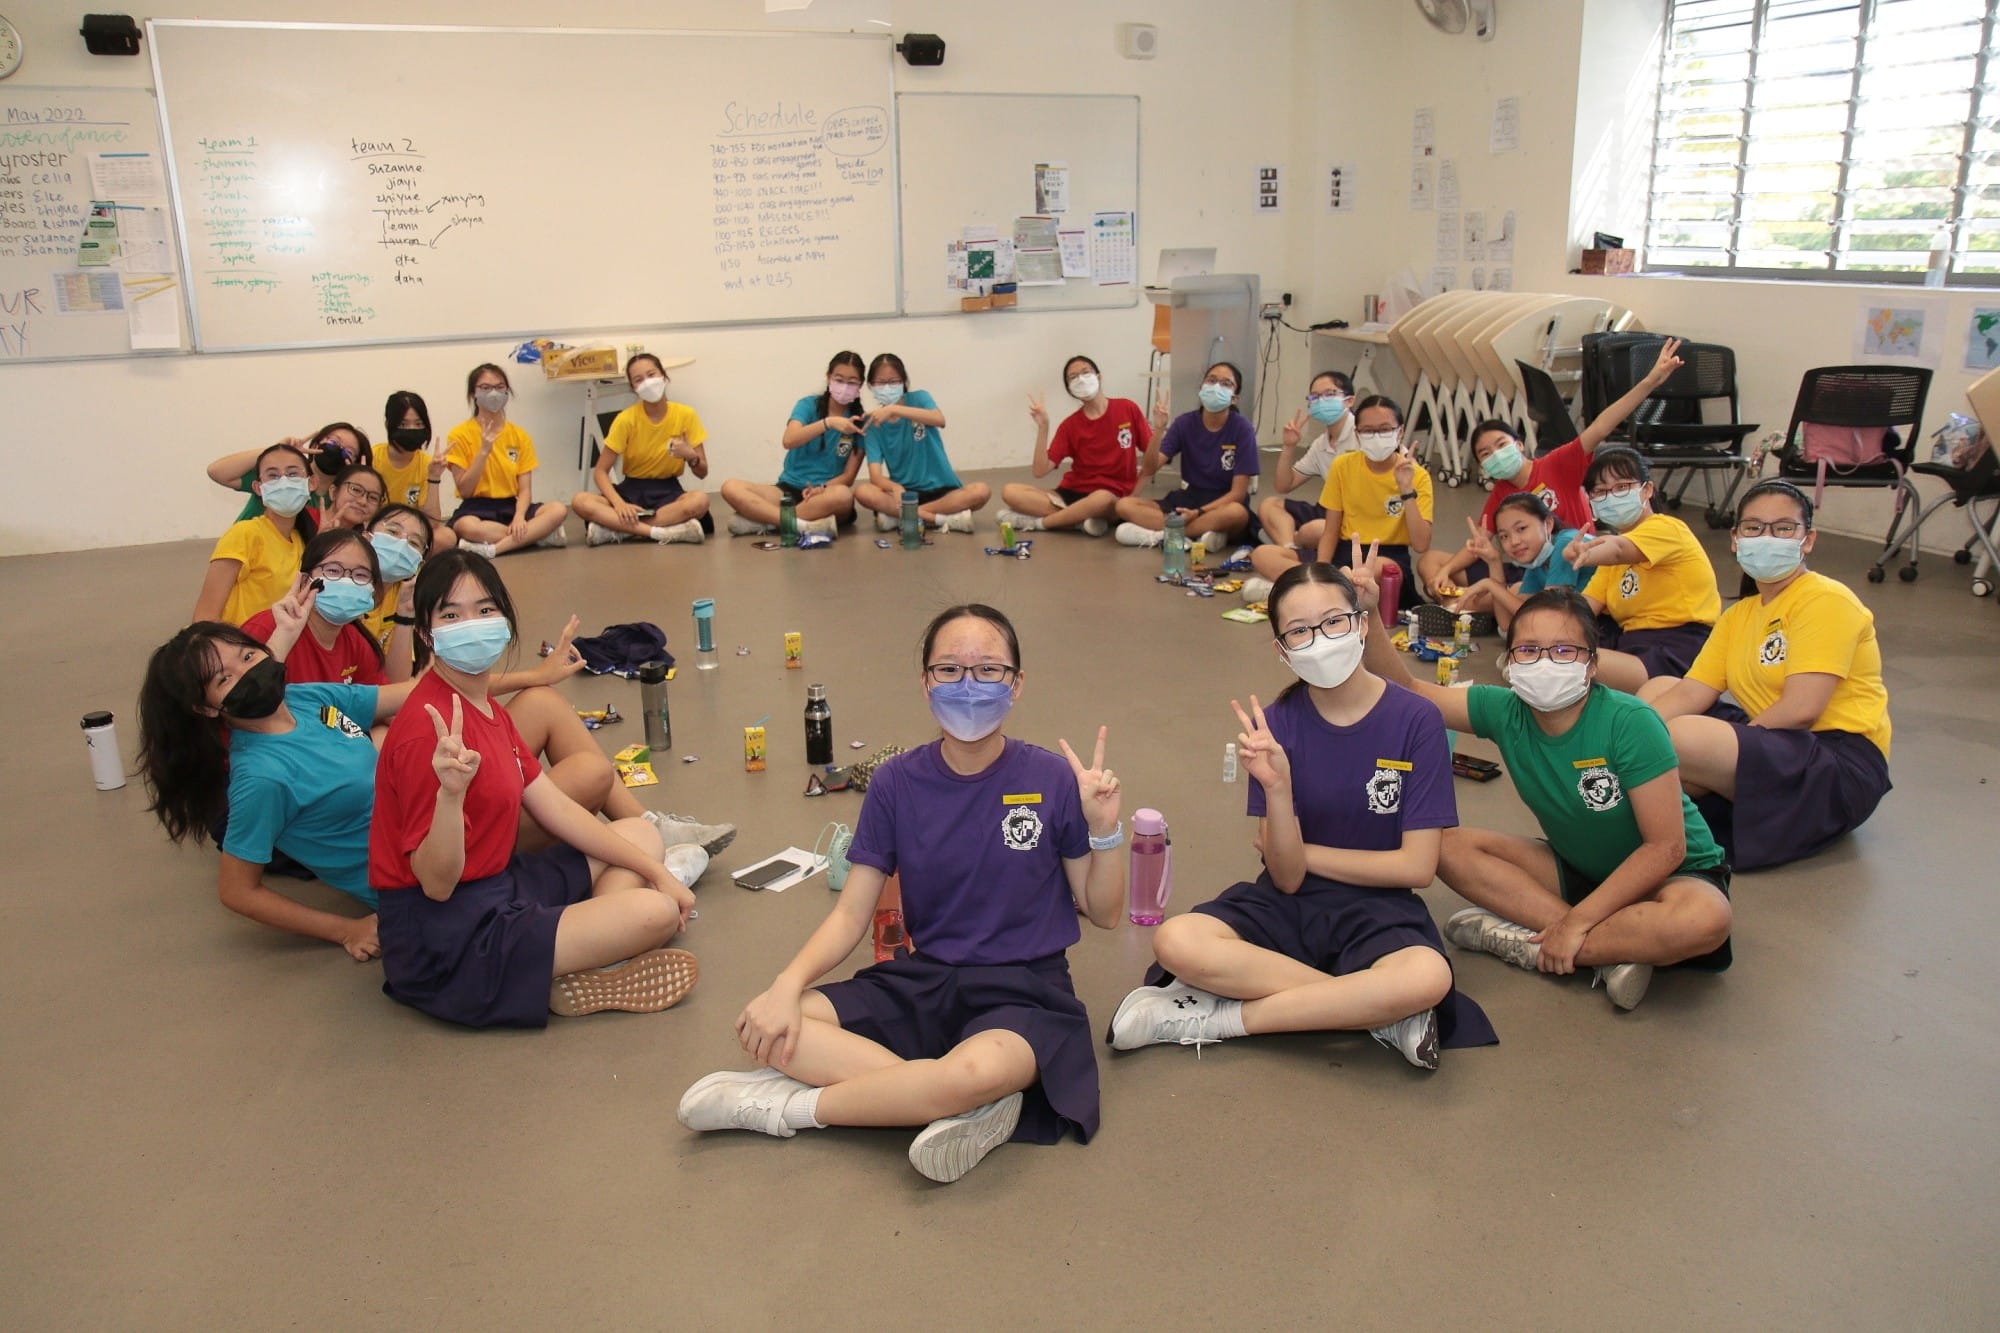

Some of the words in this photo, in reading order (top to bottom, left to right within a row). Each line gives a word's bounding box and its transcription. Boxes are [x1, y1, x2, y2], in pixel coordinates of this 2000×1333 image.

[7, 107, 40, 123] May
[45, 107, 86, 122] 2022
[721, 101, 818, 134] Schedule
[352, 137, 396, 153] team
[402, 138, 417, 152] 2
[32, 173, 73, 185] Celia
[570, 355, 596, 368] Vico
